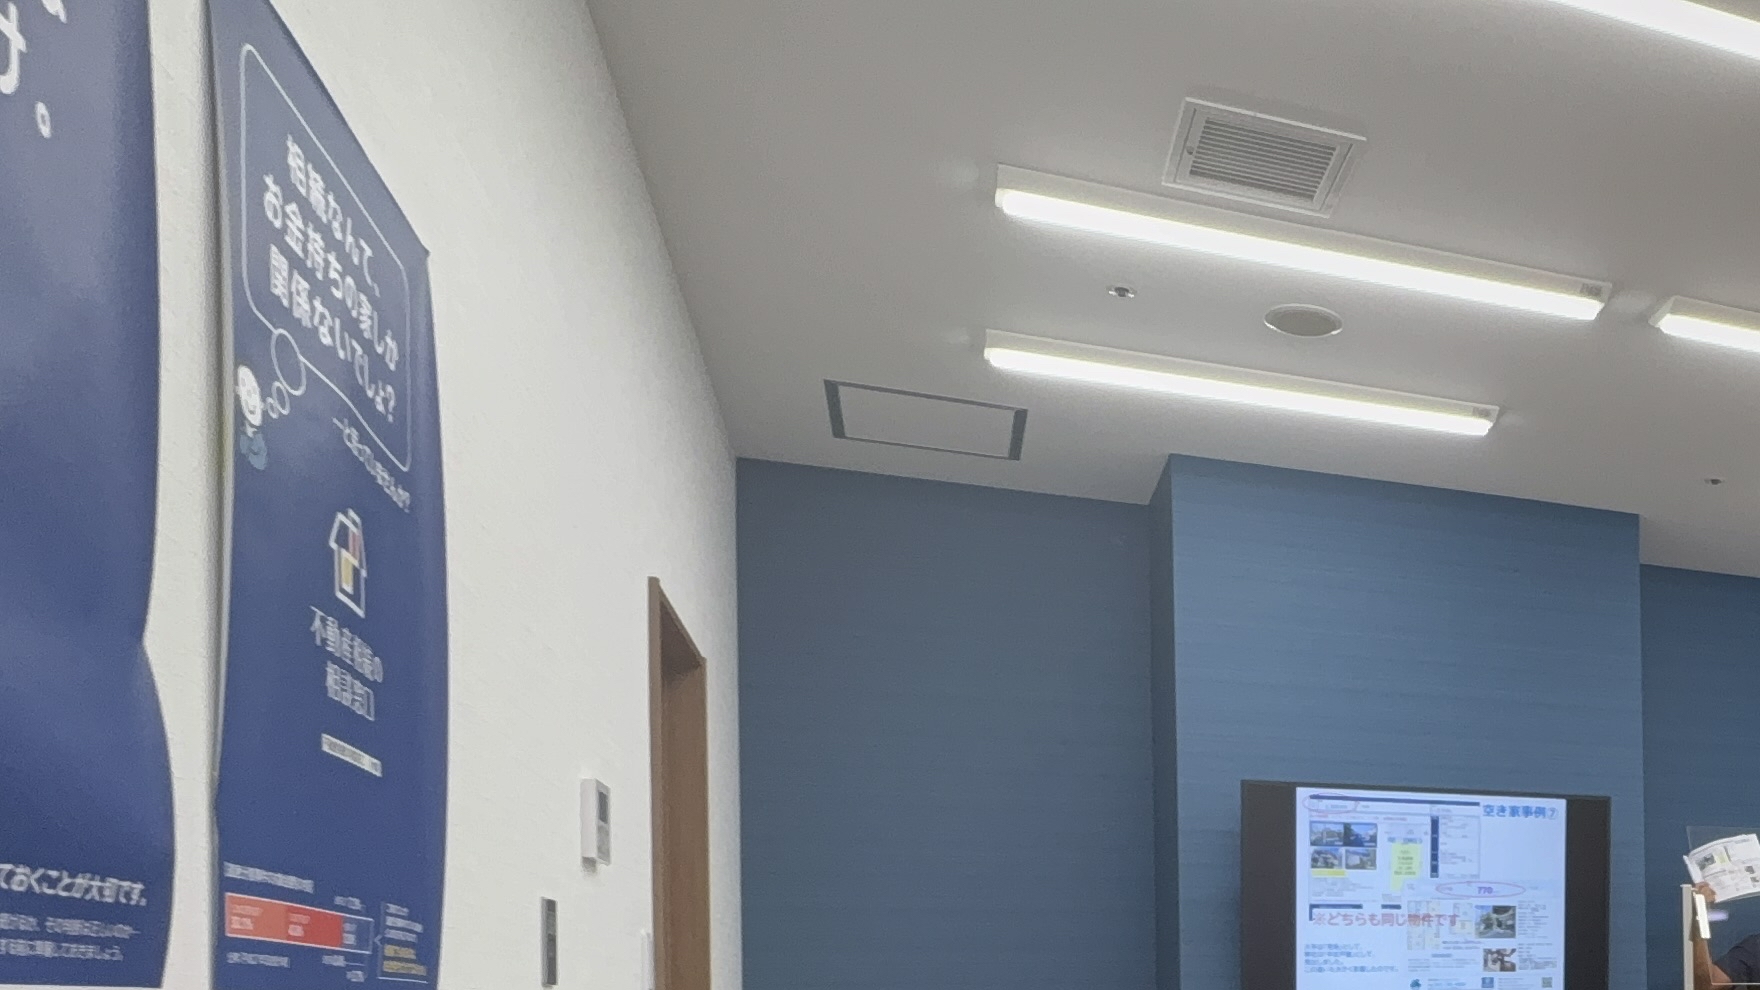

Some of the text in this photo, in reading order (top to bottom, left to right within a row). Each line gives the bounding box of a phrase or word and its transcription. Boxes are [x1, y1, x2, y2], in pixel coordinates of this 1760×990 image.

[261, 174, 399, 371] お金持ちの家しか
[286, 134, 379, 297] 相続なんて、
